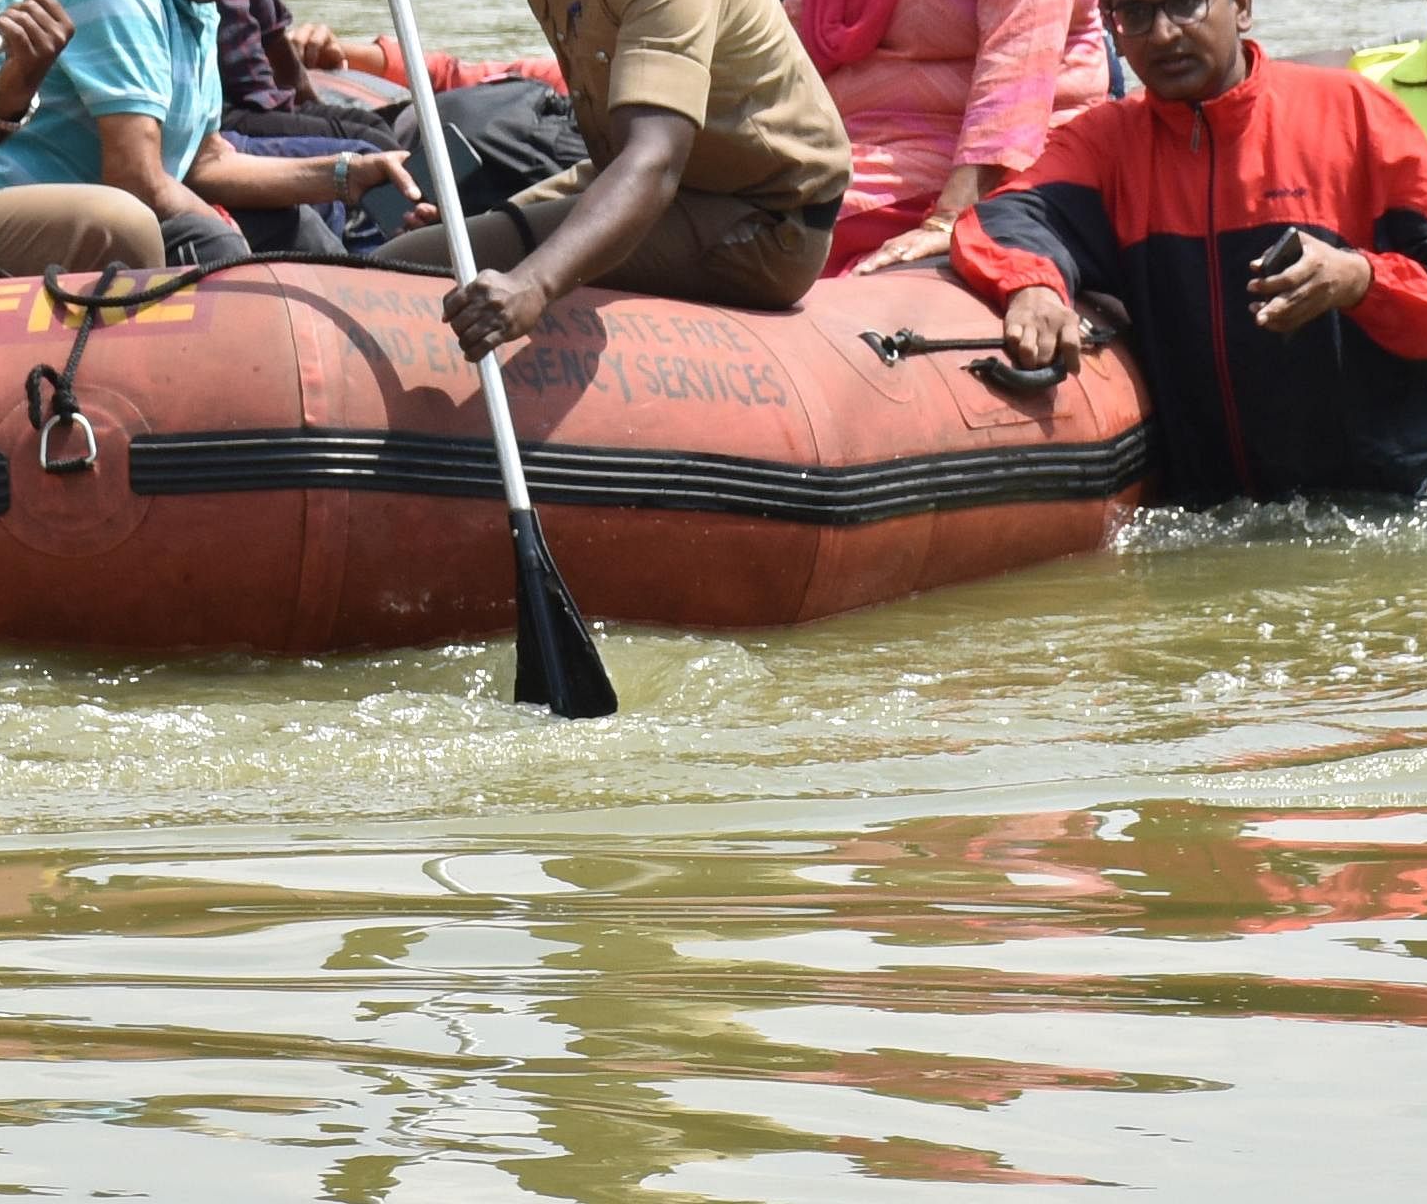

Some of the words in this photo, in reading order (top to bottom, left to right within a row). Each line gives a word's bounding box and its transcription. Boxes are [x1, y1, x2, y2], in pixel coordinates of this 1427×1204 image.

[567, 306, 671, 345] STATE
[669, 314, 753, 353] FIRE
[345, 324, 416, 366] AND
[636, 353, 787, 408] SERVICES
